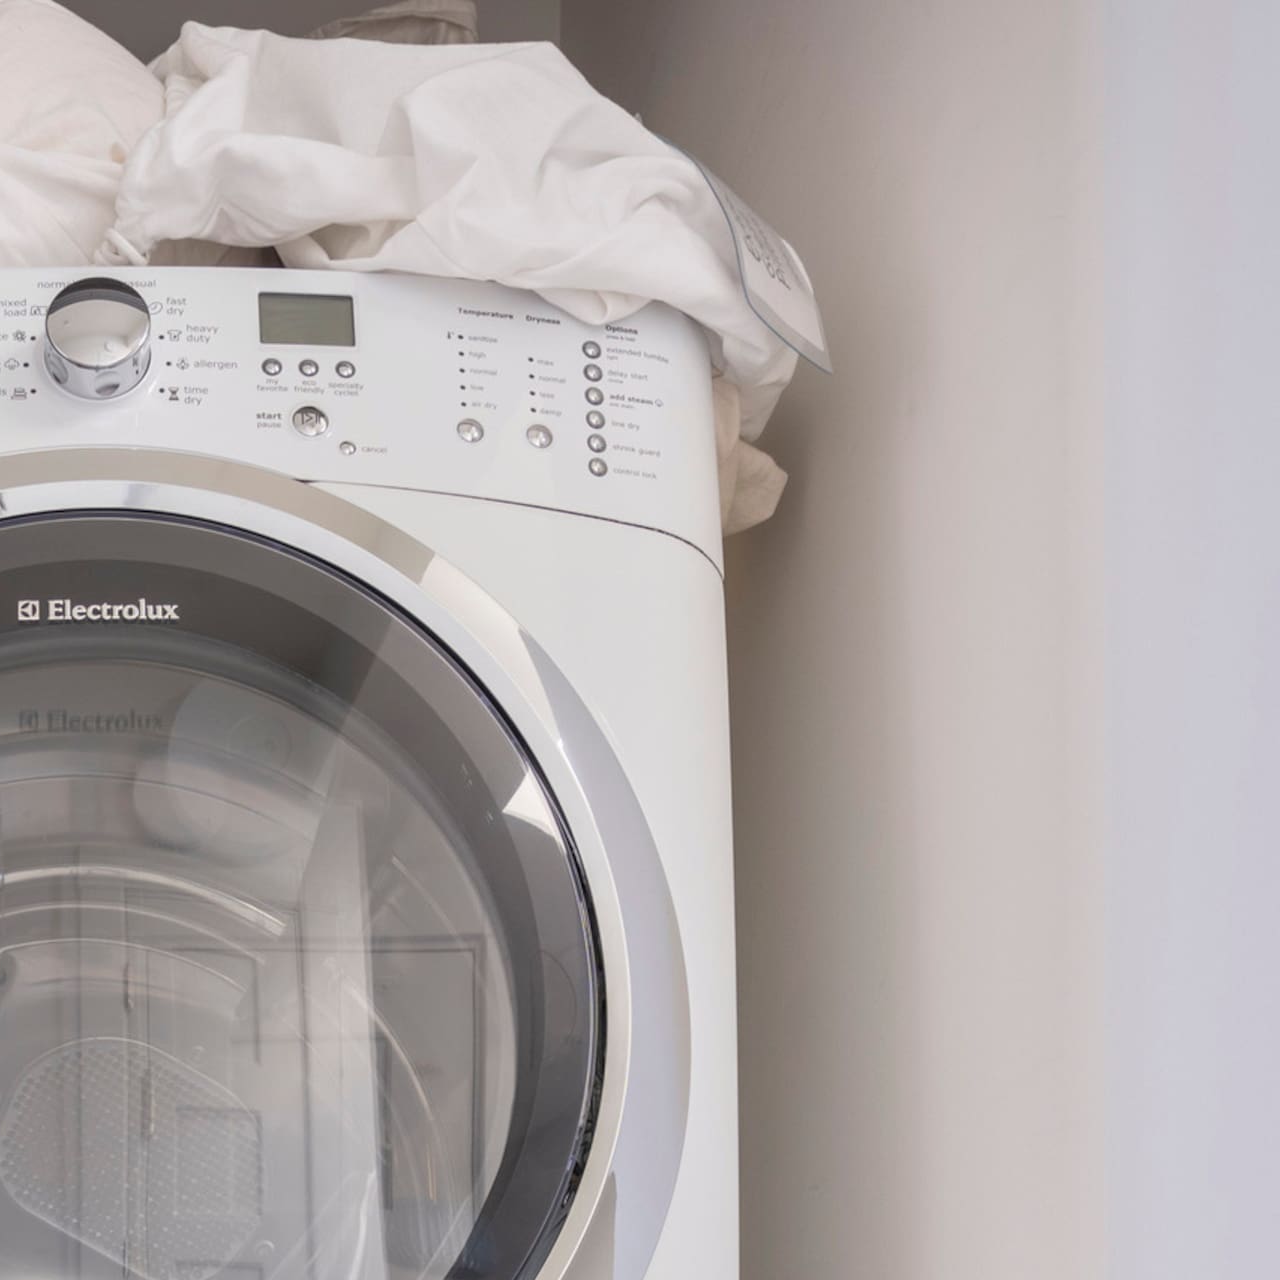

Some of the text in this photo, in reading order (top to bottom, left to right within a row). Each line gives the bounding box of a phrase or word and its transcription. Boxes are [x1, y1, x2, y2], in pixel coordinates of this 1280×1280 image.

[166, 298, 186, 306] fast
[4, 308, 27, 316] load
[166, 307, 184, 316] dry
[458, 307, 514, 319] Temperature
[526, 315, 560, 325] Dryness
[186, 324, 218, 334] heavy
[605, 324, 638, 335] Options
[186, 334, 210, 344] duty
[194, 360, 238, 370] allergen
[266, 378, 278, 386] my
[328, 382, 364, 390] specialty
[184, 386, 208, 394] time
[256, 384, 288, 392] favorite
[294, 386, 324, 395] friendly
[184, 396, 202, 406] dry
[256, 412, 282, 420] start
[256, 422, 282, 430] pause
[47, 598, 180, 621] Electrolux
